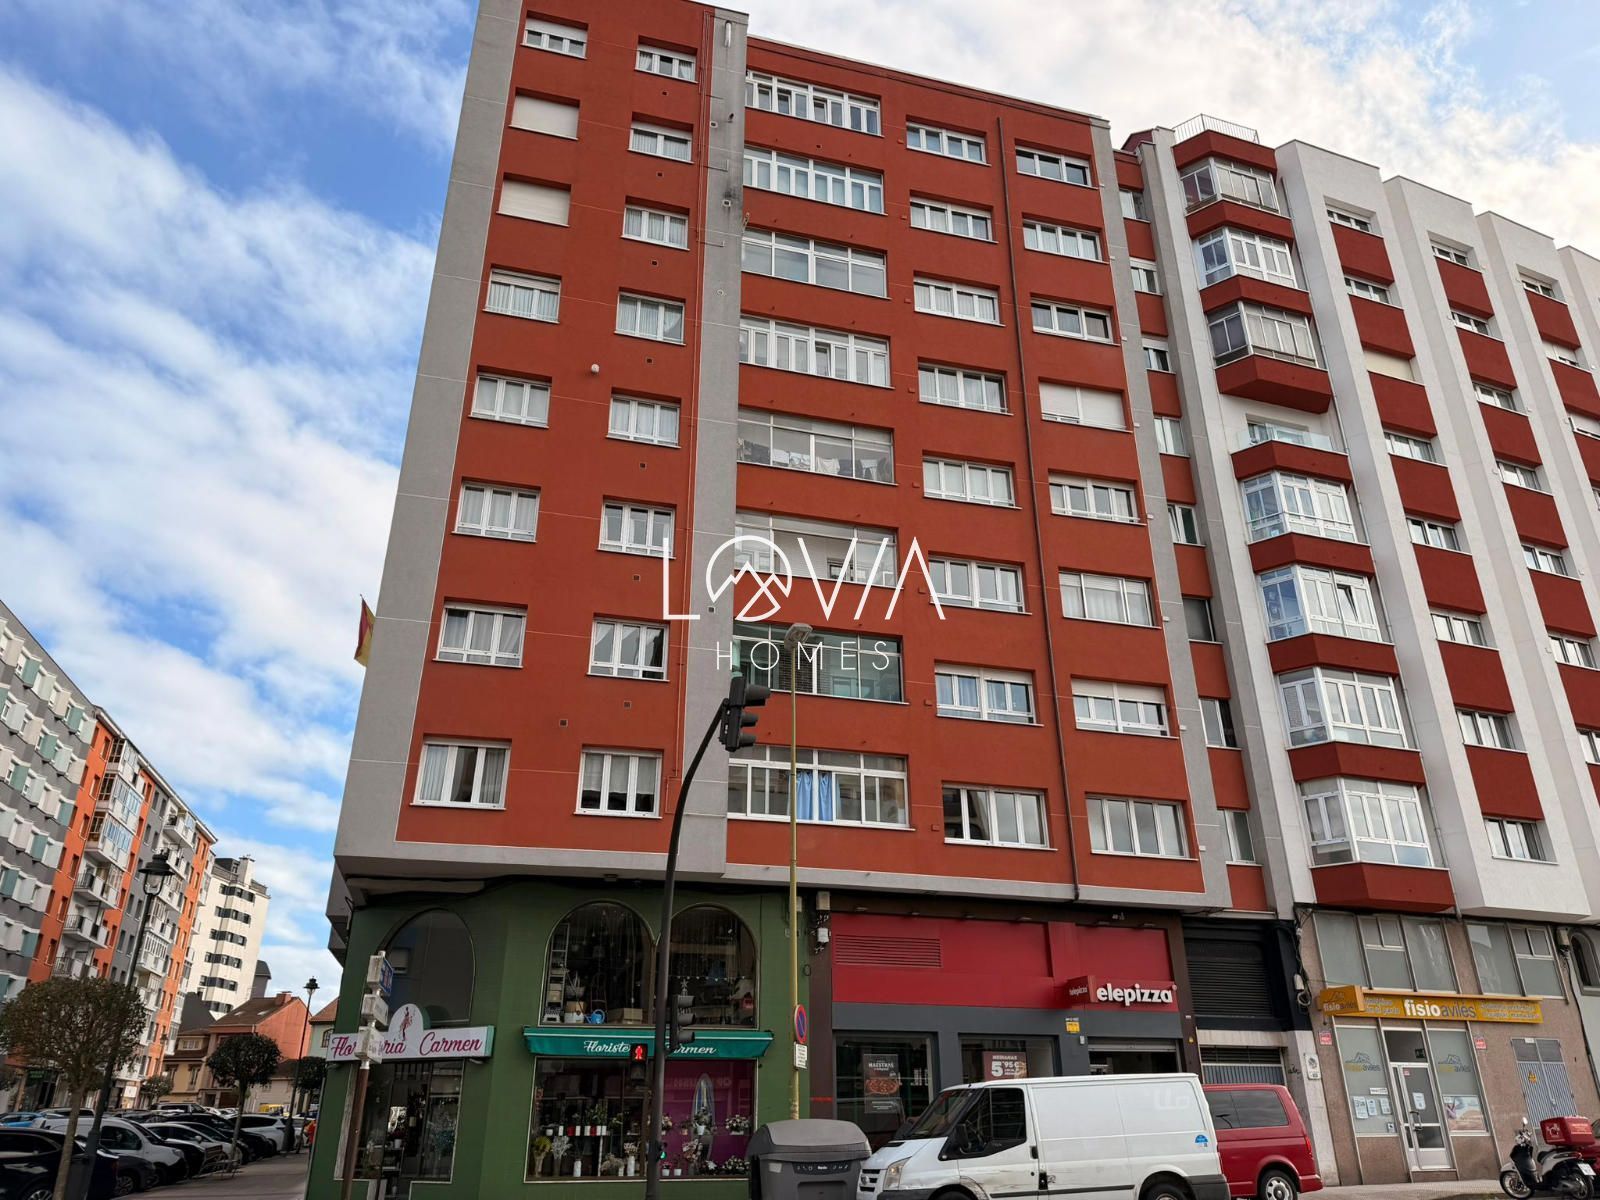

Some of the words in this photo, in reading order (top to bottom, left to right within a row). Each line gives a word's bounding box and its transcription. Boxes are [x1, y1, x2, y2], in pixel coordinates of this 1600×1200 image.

[420, 1032, 483, 1056] Carmen
[583, 1040, 631, 1053] Floriste
[674, 1044, 717, 1054] rmen
